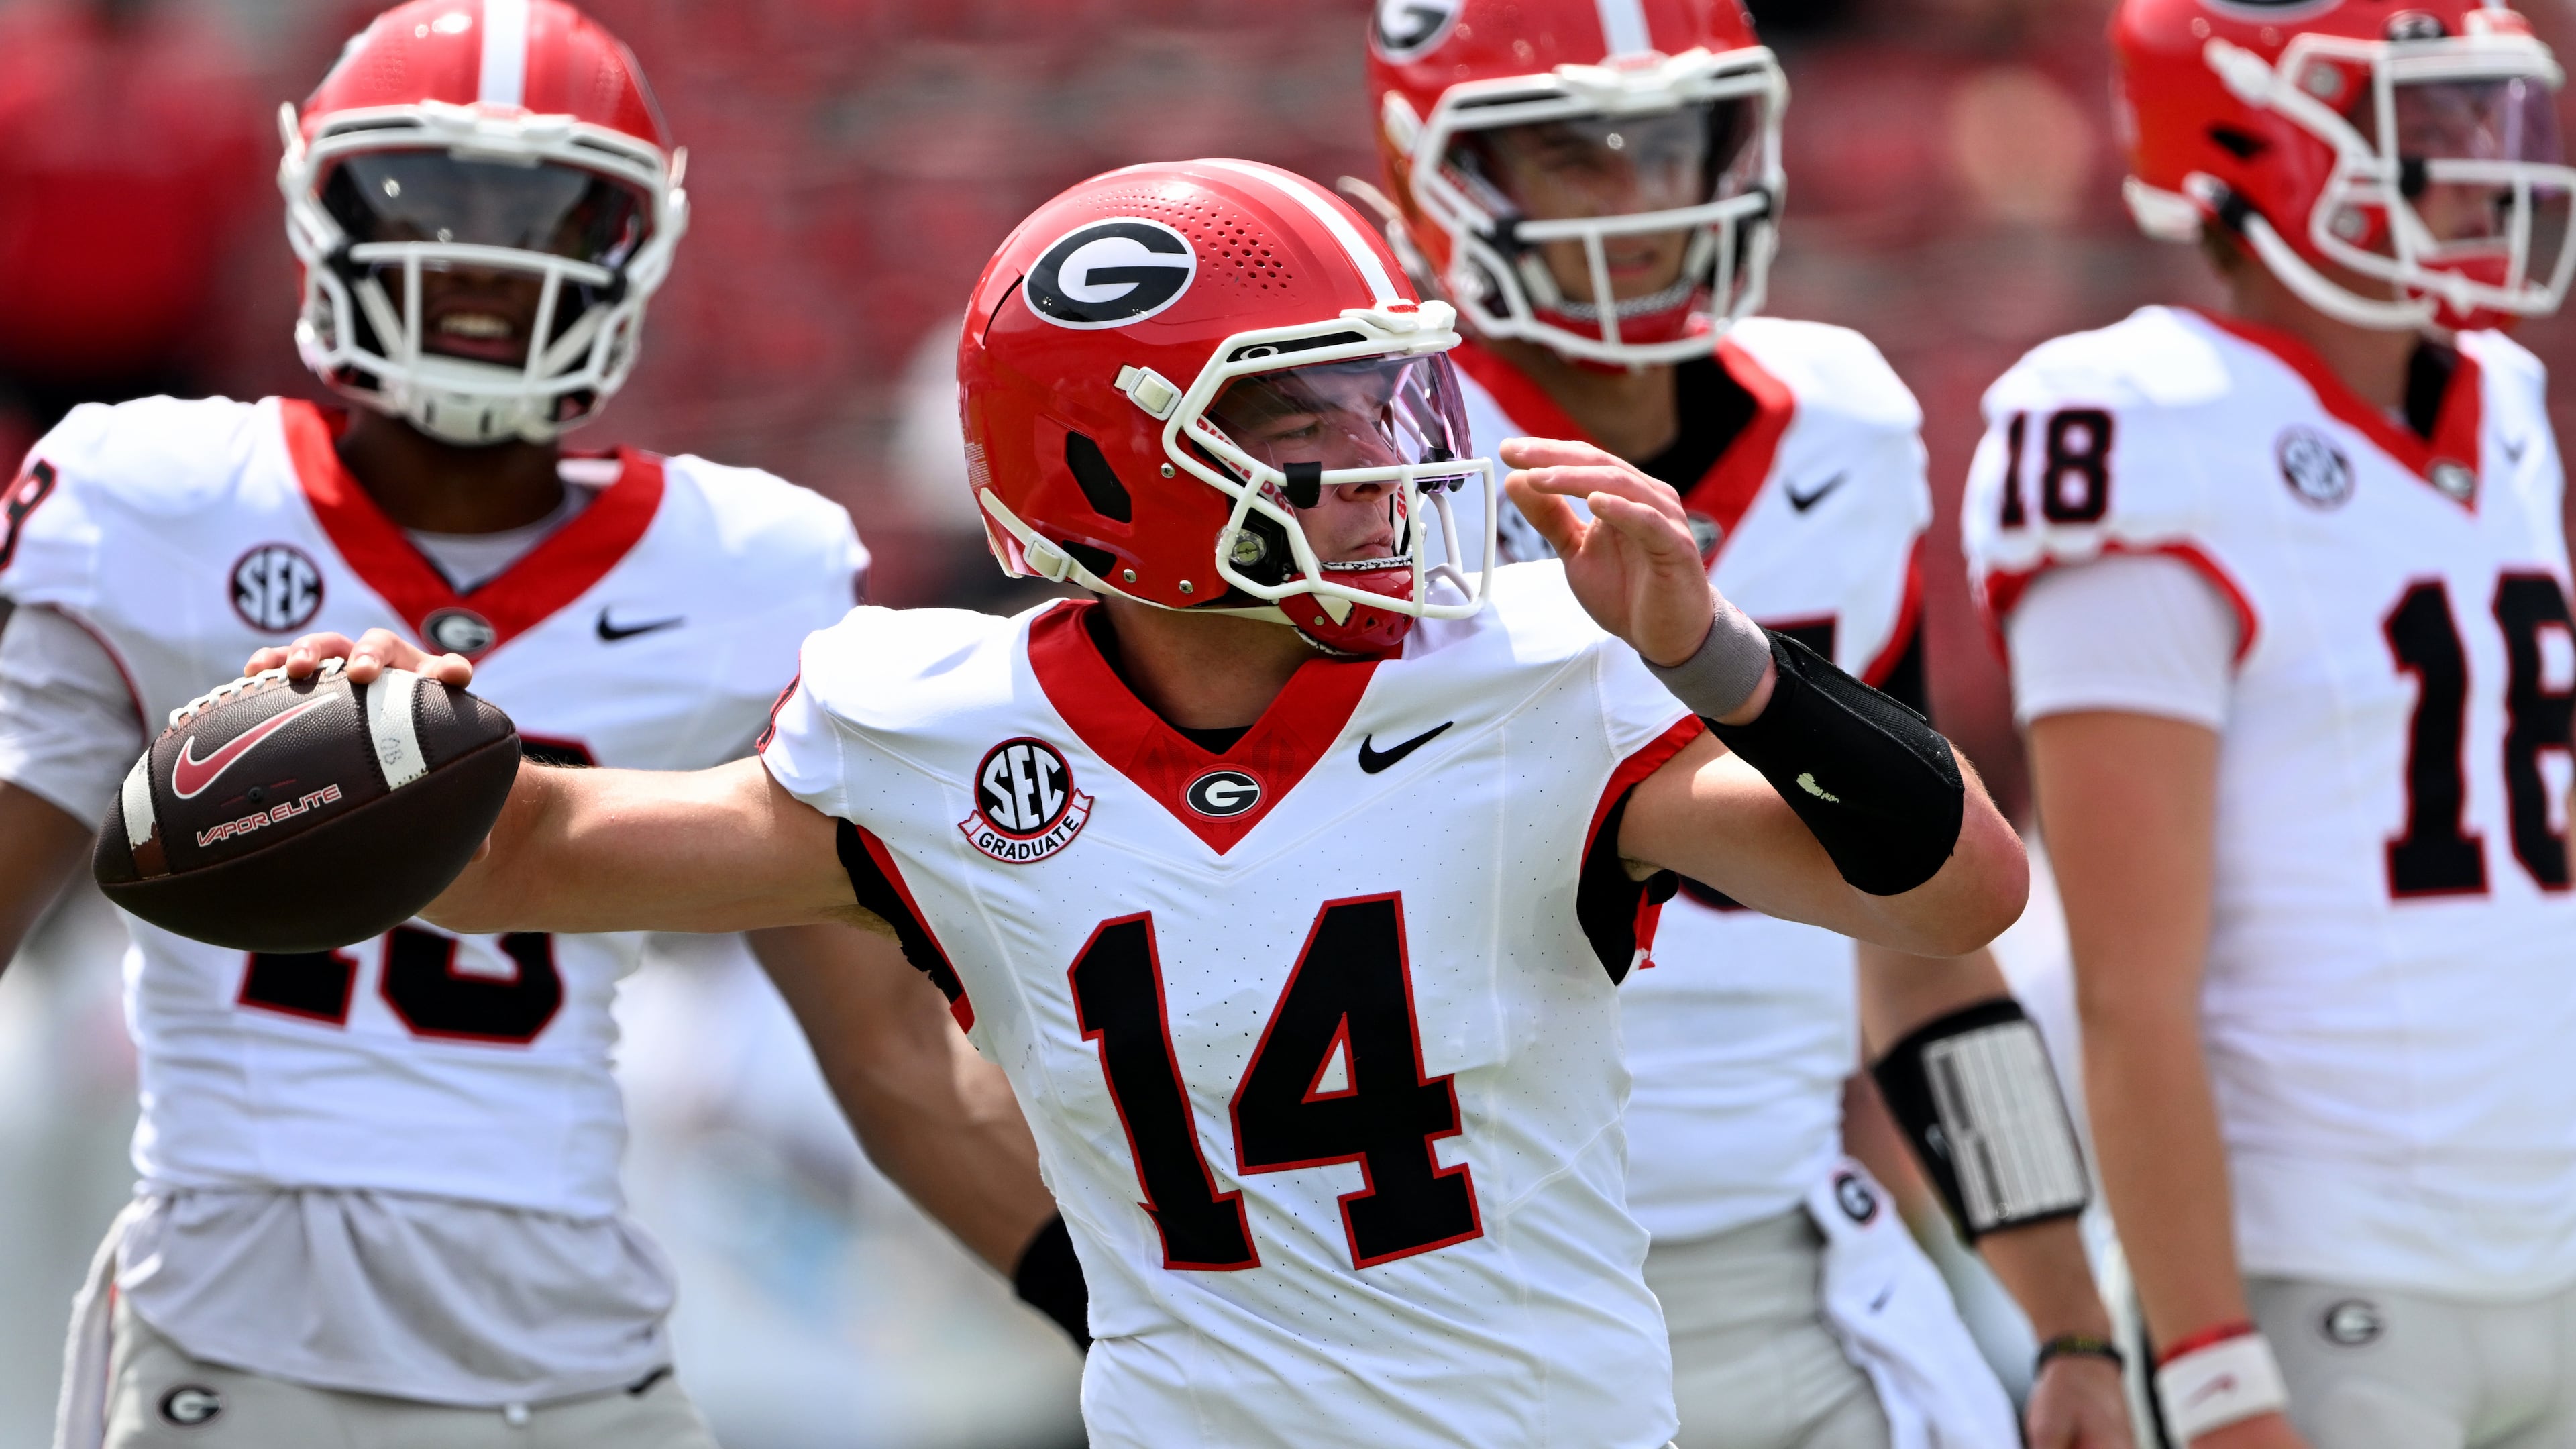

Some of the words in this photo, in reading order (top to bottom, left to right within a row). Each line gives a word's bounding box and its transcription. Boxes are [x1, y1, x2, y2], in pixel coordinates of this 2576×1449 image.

[1027, 221, 1191, 323] G
[2001, 407, 2114, 530] 18
[236, 549, 319, 629] SEC
[197, 812, 270, 847] VAPOR
[270, 783, 342, 823] ELITE
[983, 745, 1065, 830] SEC
[1186, 771, 1260, 816] G
[979, 815, 1079, 860] GRADUATE
[1067, 891, 1484, 1270] 14
[158, 1383, 221, 1426] G
